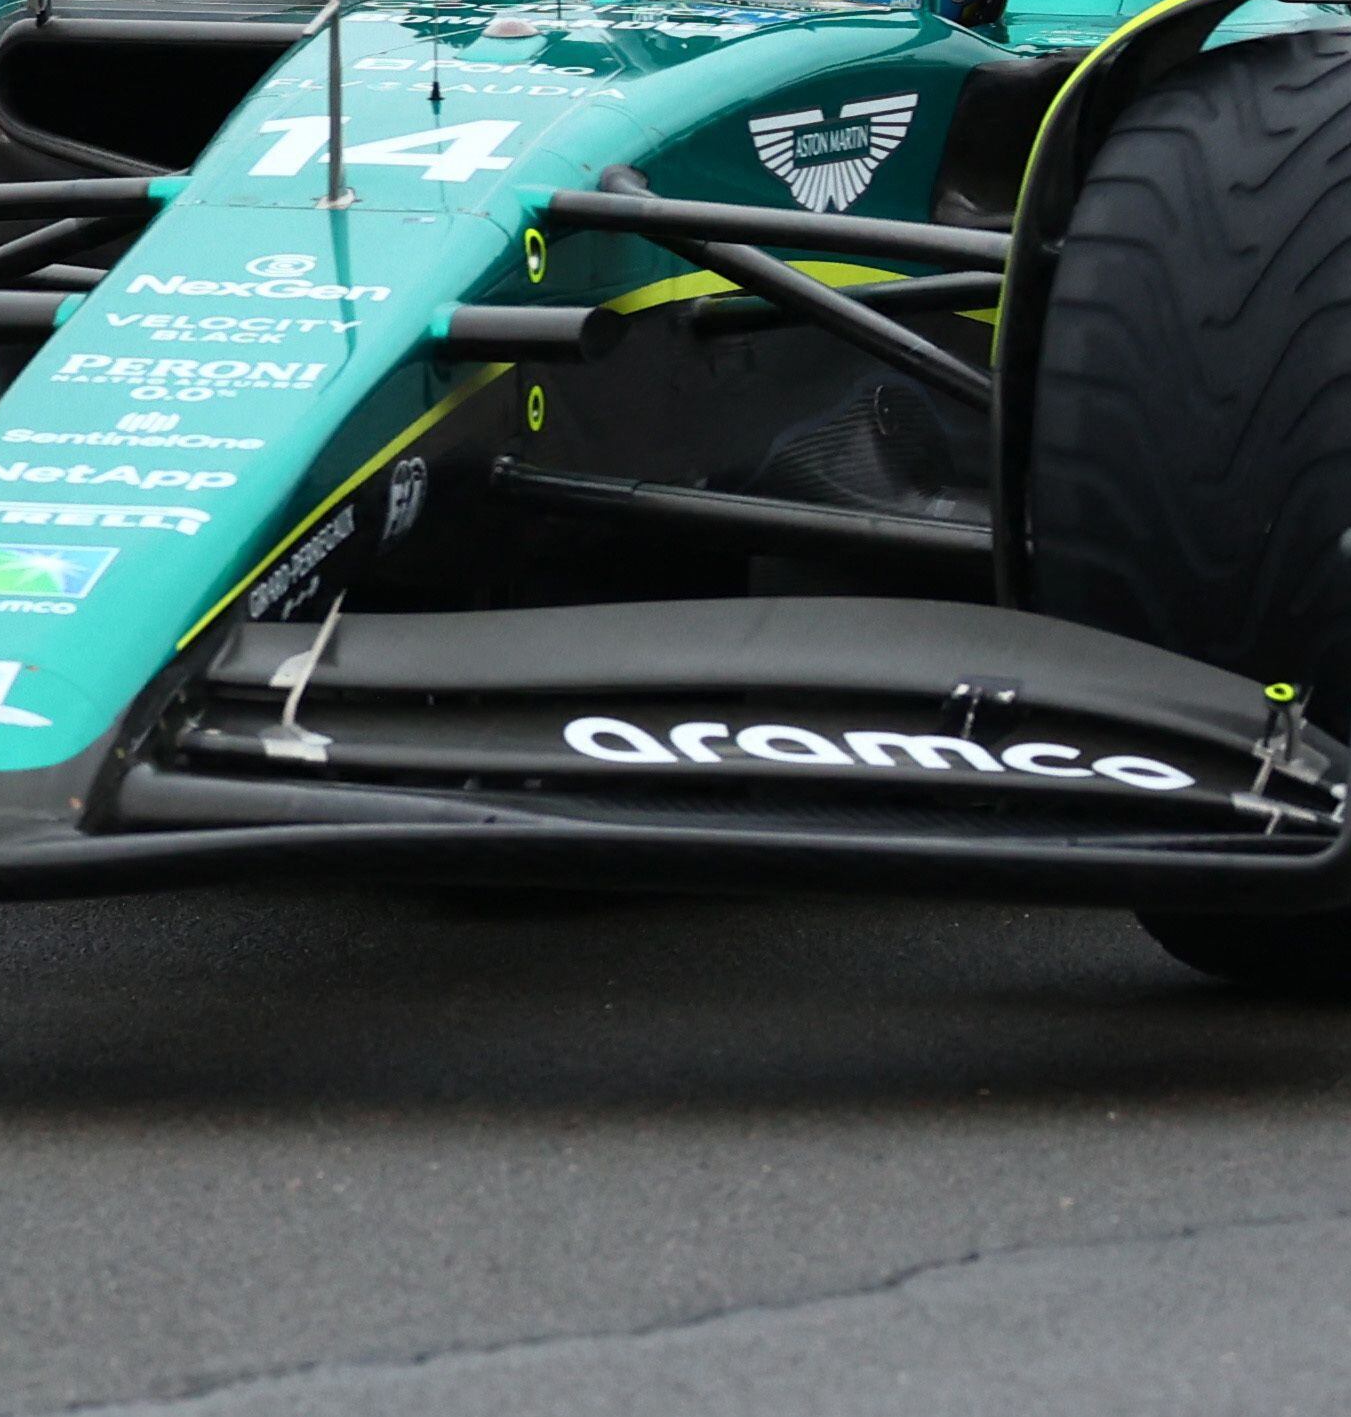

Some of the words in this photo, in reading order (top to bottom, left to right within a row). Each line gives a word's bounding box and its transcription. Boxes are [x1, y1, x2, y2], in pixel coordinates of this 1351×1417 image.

[344, 10, 760, 33] BOMARDIER
[418, 59, 595, 76] Porto
[248, 115, 522, 183] 14
[126, 274, 392, 302] NexGen
[106, 313, 363, 335] VELOCITY
[150, 329, 287, 344] BLACK
[59, 353, 328, 382] PERONI
[1, 427, 265, 451] SentinelOne
[563, 716, 1197, 790] aramco
